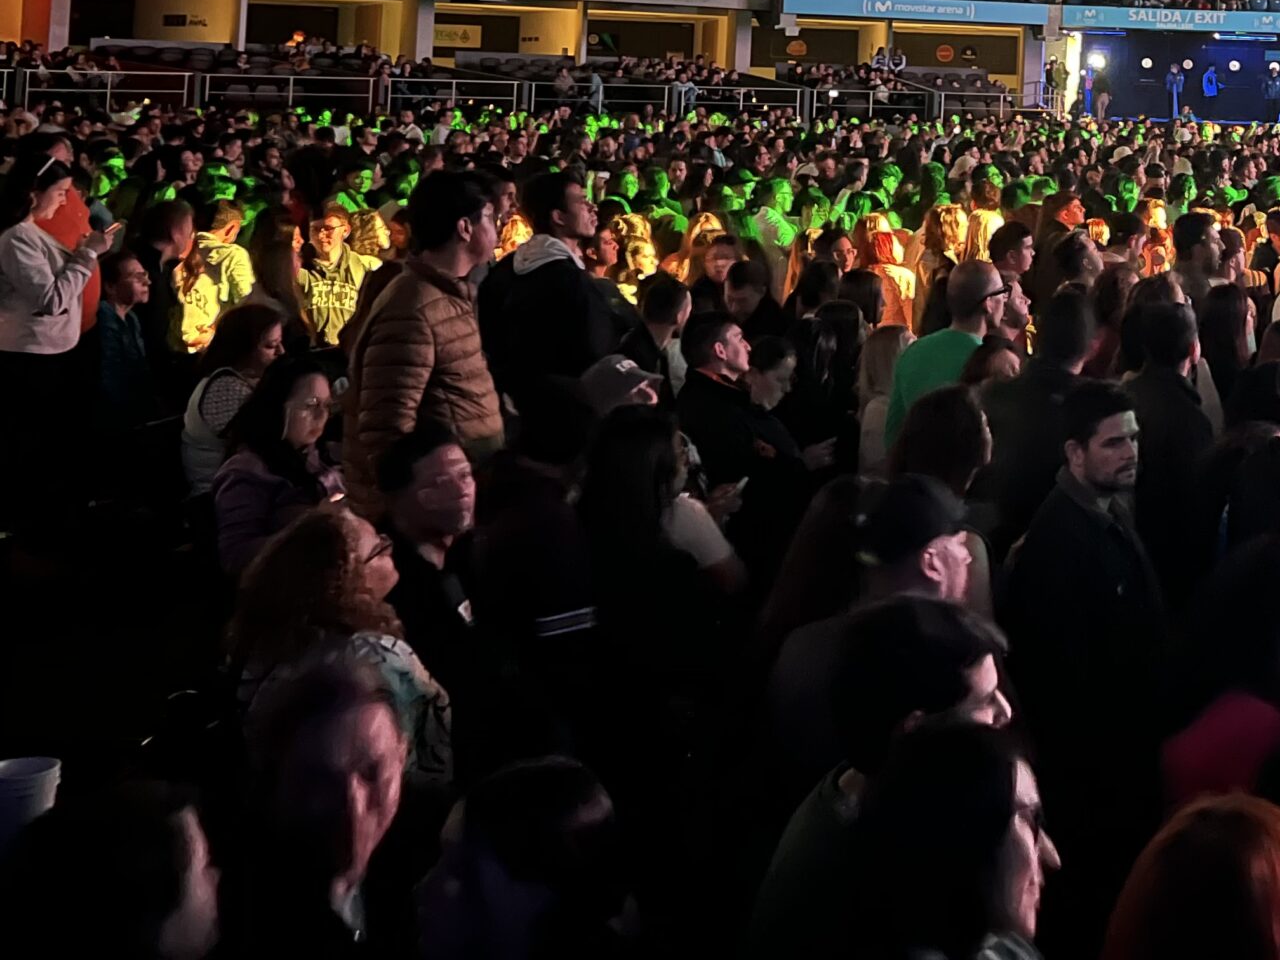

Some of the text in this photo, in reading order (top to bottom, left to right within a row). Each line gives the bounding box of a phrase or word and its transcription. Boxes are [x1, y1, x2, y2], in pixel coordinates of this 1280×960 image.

[894, 3, 936, 13] movistar
[937, 5, 963, 15] arena
[1128, 9, 1182, 23] SALIDA
[1195, 11, 1227, 24] EXIT
